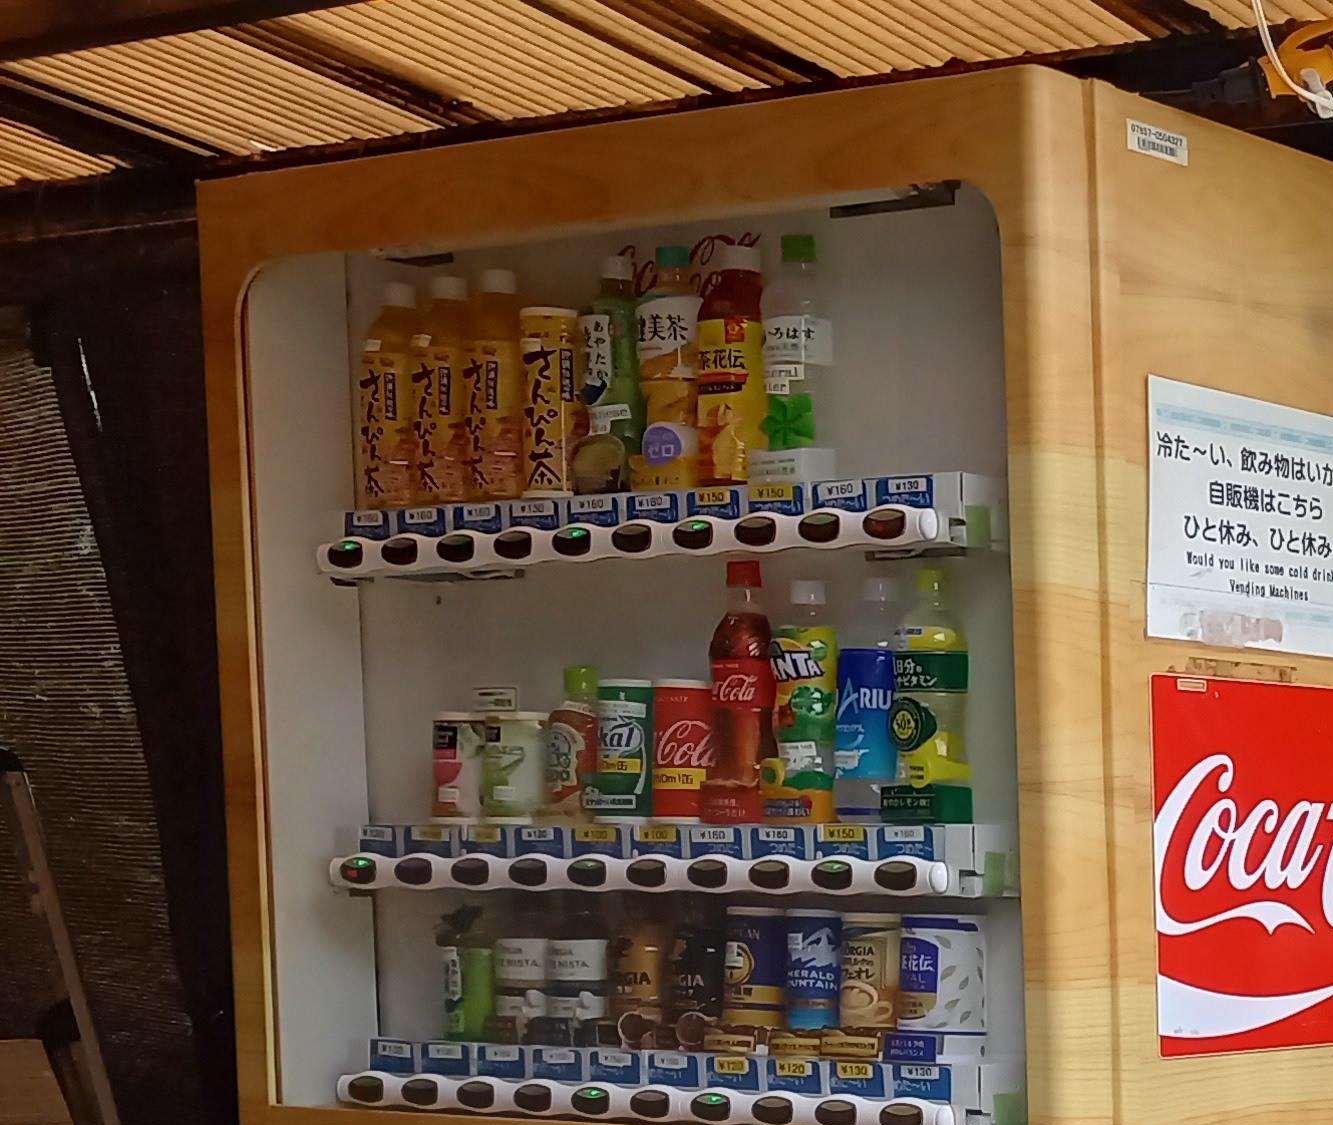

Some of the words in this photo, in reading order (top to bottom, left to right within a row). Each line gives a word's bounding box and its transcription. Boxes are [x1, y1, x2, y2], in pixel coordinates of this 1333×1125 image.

[461, 358, 489, 486] さんぴん茶
[522, 346, 562, 487] さんぴん茶
[360, 369, 385, 497] さんぴん茶
[412, 363, 440, 492] さんぴん茶
[698, 491, 725, 503] ¥150
[757, 487, 785, 499] ¥150
[827, 483, 854, 496] ¥160
[1209, 480, 1324, 521] 自販機はこちら
[1186, 550, 1215, 568] Would
[1218, 556, 1235, 571] you
[1240, 557, 1260, 574] like
[1265, 564, 1285, 577] some
[1288, 565, 1309, 580] cold
[1229, 579, 1266, 599] Vending
[1269, 584, 1309, 602] Machines
[770, 652, 824, 681] ANTA
[720, 674, 758, 702] Cola
[828, 828, 855, 840] ¥150
[842, 967, 876, 980] フェオレ
[789, 980, 839, 991] UNTAIN
[779, 1063, 805, 1074] ¥120
[840, 1065, 868, 1077] ¥130
[907, 1067, 932, 1077] ¥130
